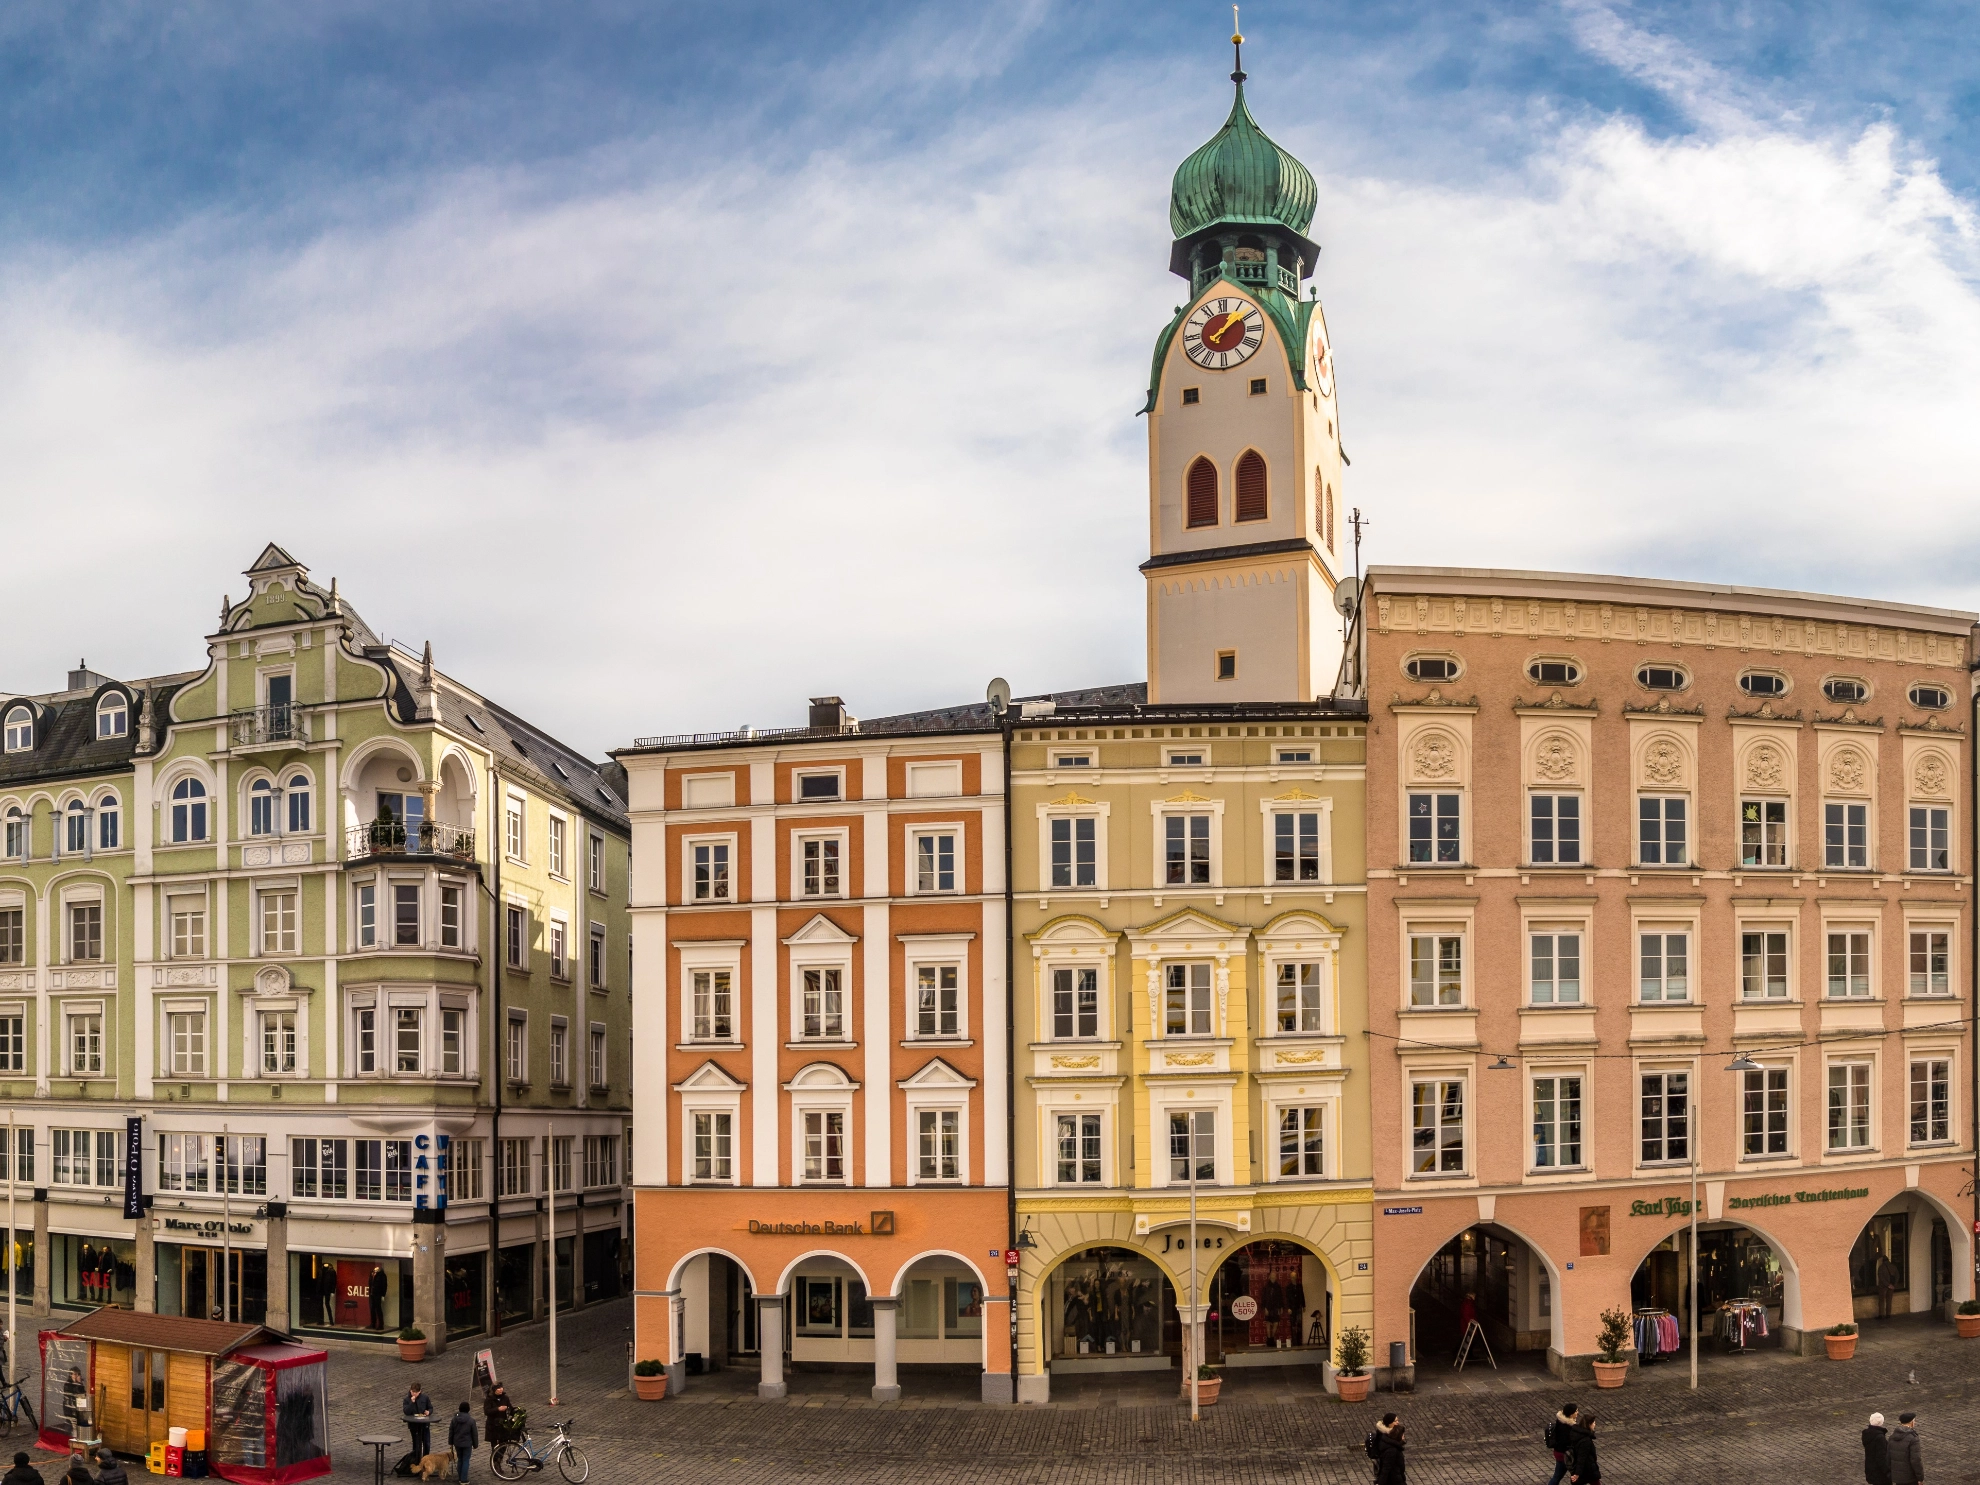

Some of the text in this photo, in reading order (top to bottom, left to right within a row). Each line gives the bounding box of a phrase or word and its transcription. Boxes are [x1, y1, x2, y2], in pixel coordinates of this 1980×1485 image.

[130, 1175, 138, 1214] Marc
[1794, 1187, 1869, 1203] Trachtenhaus
[1629, 1198, 1663, 1216] Karl
[164, 1218, 202, 1230] Marc
[749, 1220, 864, 1234] Deutsche Bank
[1162, 1234, 1222, 1253] Joes
[82, 1271, 110, 1289] SALE
[347, 1285, 370, 1297] SALE
[454, 1290, 471, 1309] SALE
